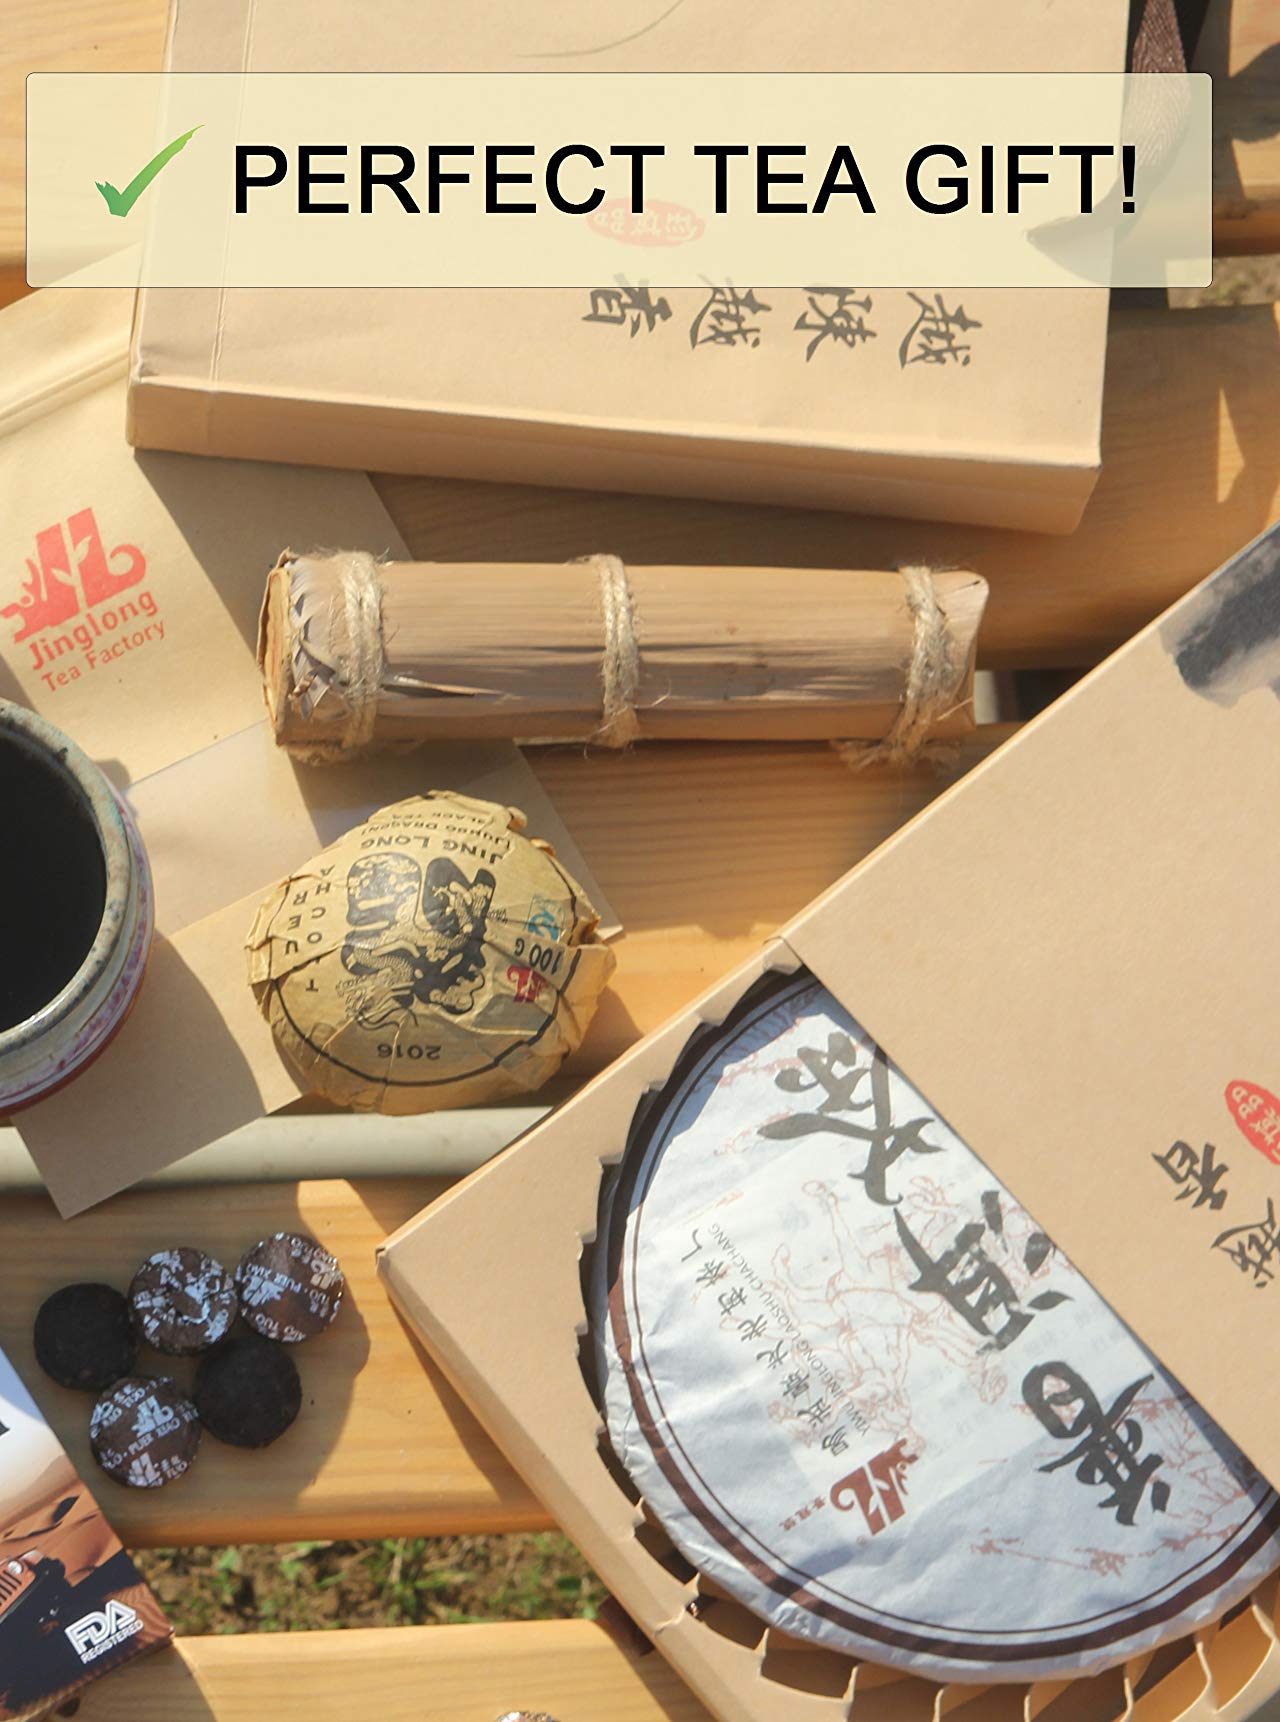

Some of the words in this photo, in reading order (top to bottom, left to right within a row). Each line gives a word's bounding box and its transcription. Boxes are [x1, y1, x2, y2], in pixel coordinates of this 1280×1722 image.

[29, 590, 160, 671] Jinglong
[41, 664, 81, 692] Tea
[84, 619, 162, 670] Factory
[360, 835, 429, 847] LONG
[442, 839, 502, 863] JING
[513, 937, 525, 956] G
[527, 943, 561, 974] 100
[375, 1043, 440, 1059] 2016
[705, 1220, 766, 1292] CHACHANG
[273, 1272, 301, 1292] PUER
[757, 1031, 1172, 1526] 普洱茶
[680, 1228, 848, 1458] 易武景龙老树茶厂
[839, 1399, 874, 1437] YIWU
[127, 1433, 153, 1455] PUER
[63, 1599, 136, 1654] FDA
[80, 1619, 144, 1664] REGISTERED
